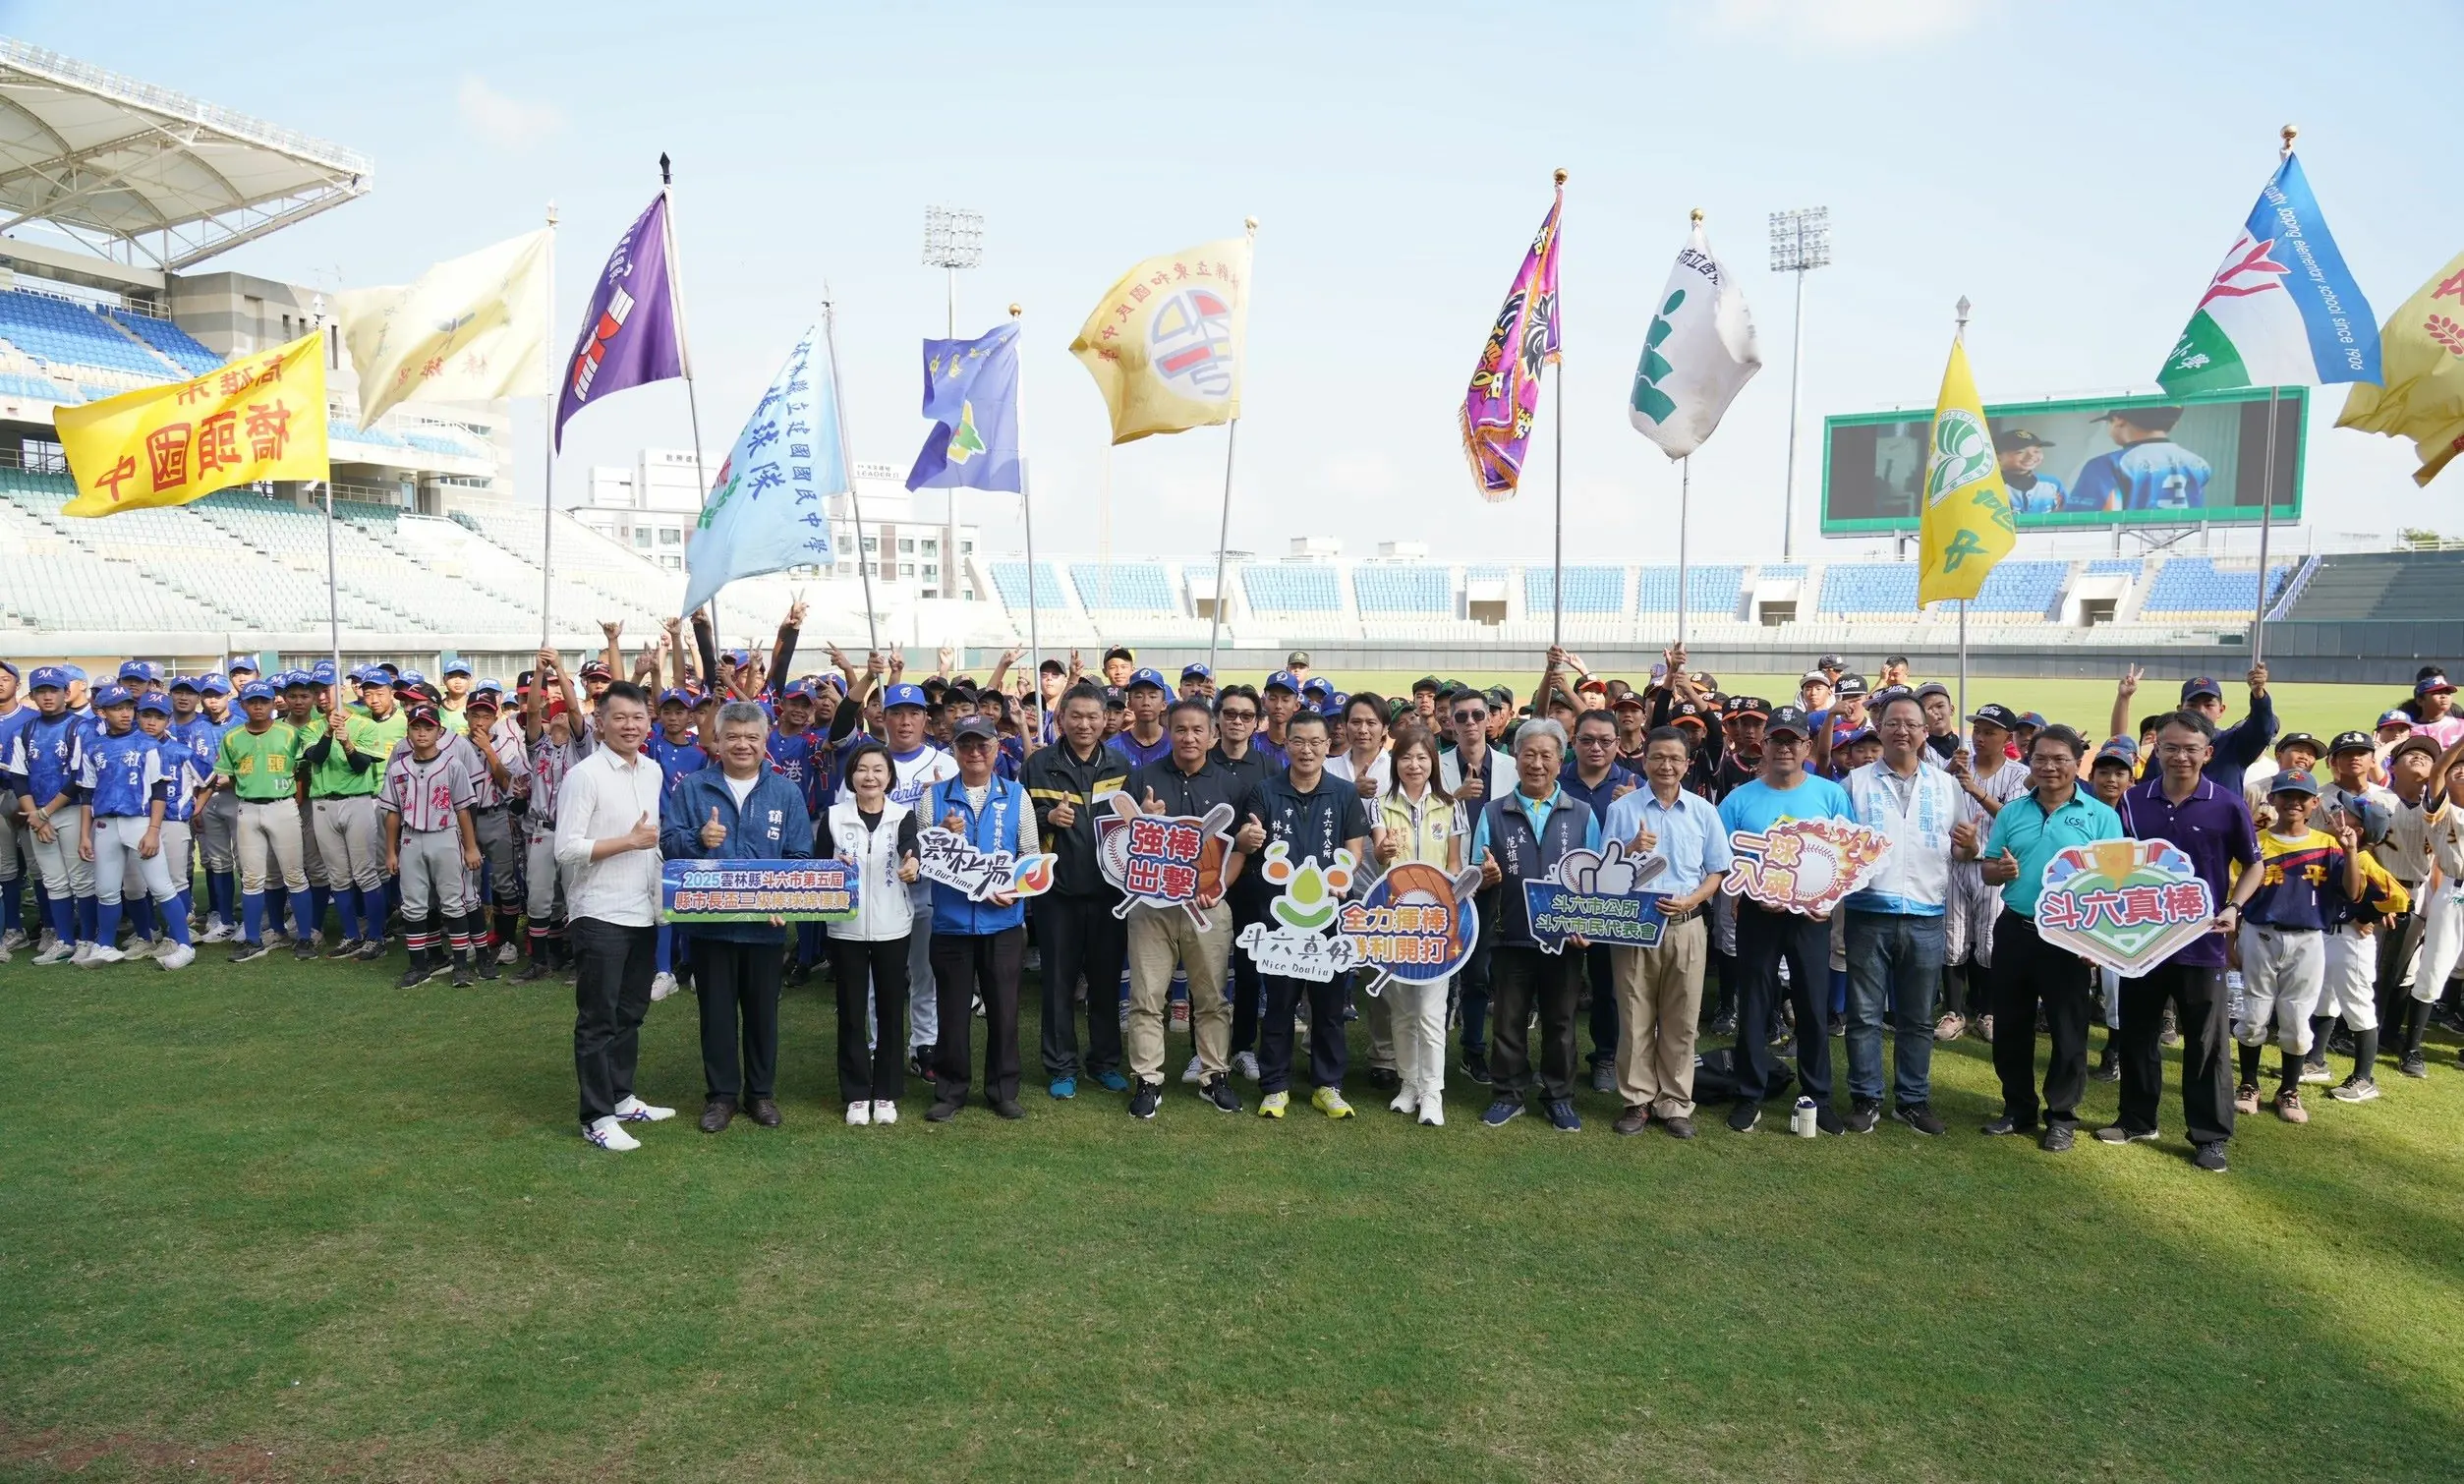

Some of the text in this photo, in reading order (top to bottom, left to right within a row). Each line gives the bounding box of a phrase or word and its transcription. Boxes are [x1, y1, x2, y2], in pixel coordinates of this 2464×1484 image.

[2293, 240, 2324, 282] elementary
[2318, 285, 2343, 314] school
[2332, 314, 2354, 344] since
[2344, 348, 2365, 371] 1906
[94, 750, 142, 771] 馬祖
[130, 771, 138, 784] 2
[167, 785, 176, 797] 8
[438, 815, 448, 828] 4
[1284, 808, 1293, 834] 市長
[1322, 807, 1333, 859] 斗六市公所
[1131, 822, 1200, 861] 強棒
[1517, 827, 1527, 843] 代表
[1506, 835, 1519, 875] 范植增
[1736, 833, 1801, 866] 一球
[683, 871, 844, 888] 2025雲林縣斗六市第五屆
[934, 869, 952, 881] Our
[951, 876, 973, 889] Time
[1126, 861, 1196, 898] 出擊
[1728, 861, 1794, 901] 入魂
[675, 891, 850, 910] 縣市長盃三級棒球錦標賽
[1551, 893, 1640, 918] 斗六市公所
[2043, 884, 2206, 930] 斗六真棒
[2311, 889, 2317, 906] 1
[1343, 906, 1447, 933] 全力揮棒
[1535, 914, 1658, 941] 斗六市民代表會
[1242, 928, 1353, 965] 斗六真好
[1261, 959, 1329, 977] Nice Douliu
